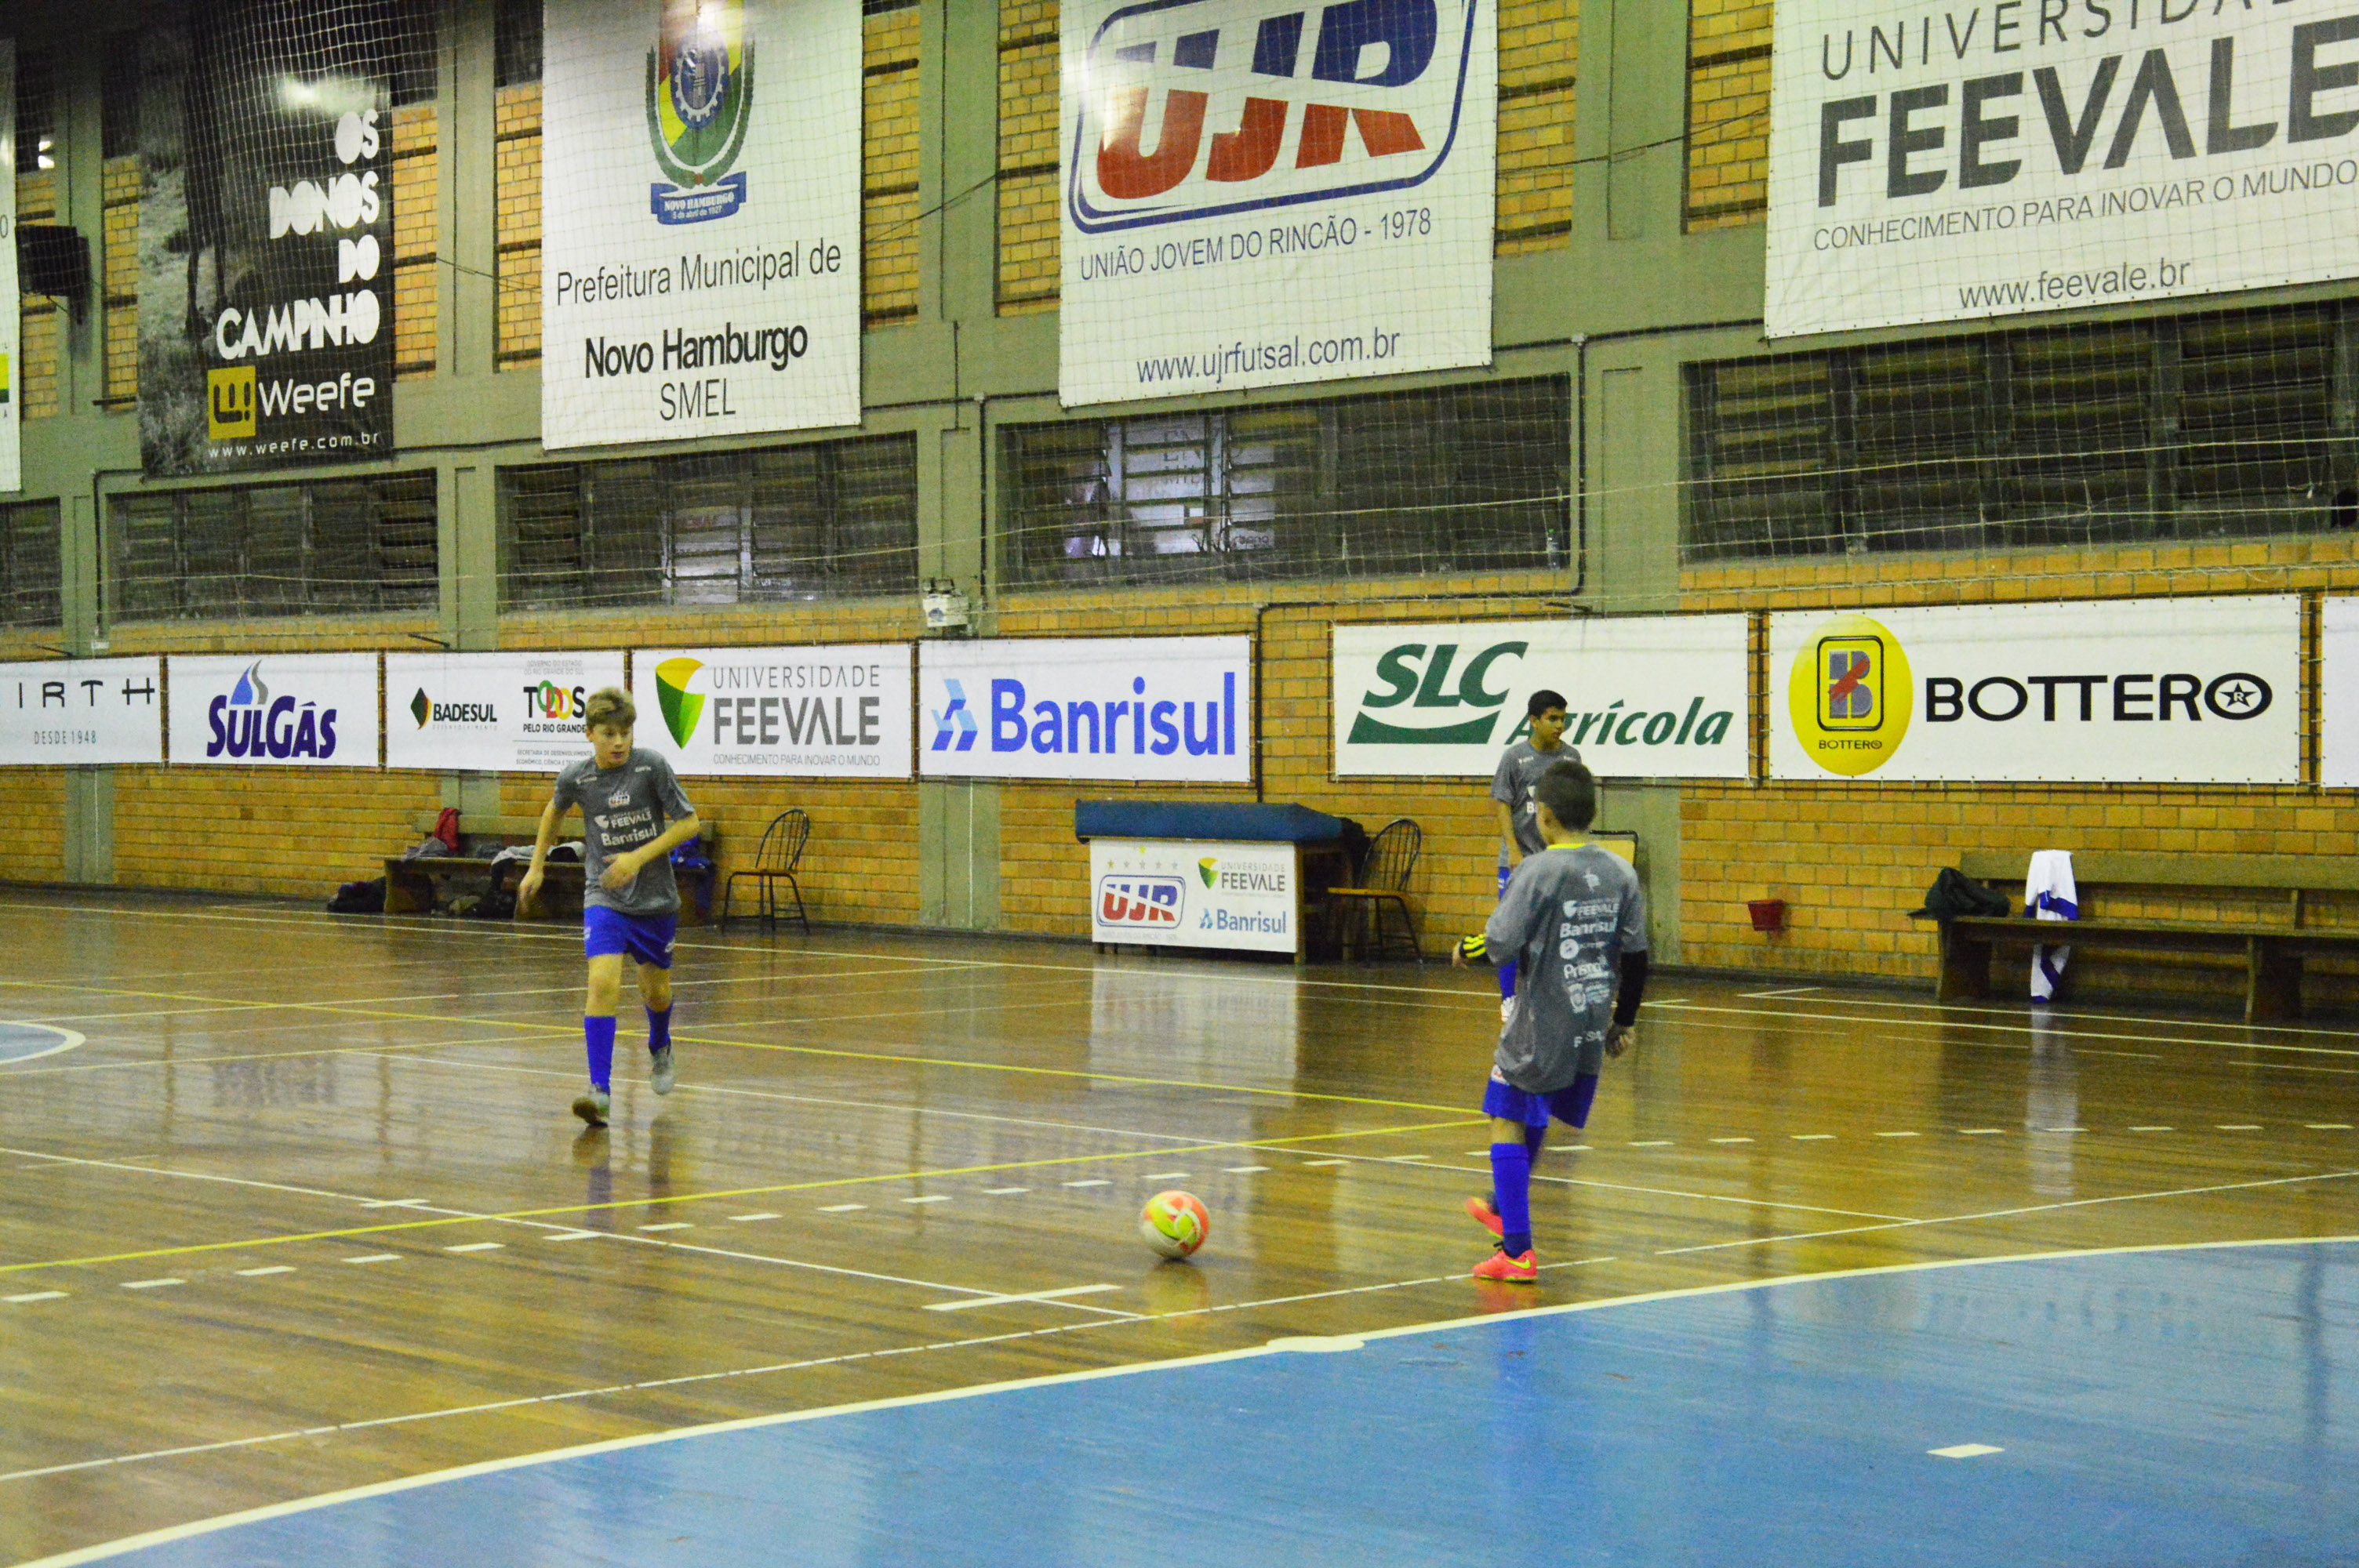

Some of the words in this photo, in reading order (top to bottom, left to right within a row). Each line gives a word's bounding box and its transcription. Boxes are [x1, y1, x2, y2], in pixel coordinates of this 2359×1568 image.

[1821, 0, 2294, 81] UNIVERSID
[1097, 0, 1438, 199] UJR
[1818, 14, 2359, 209] FEEVALE
[334, 108, 380, 164] OS
[269, 170, 380, 239] DONOS
[664, 200, 686, 211] NOVO
[687, 191, 735, 209] HAMBURGO
[1813, 205, 2016, 251] CONHECIMENTO
[2023, 195, 2094, 226] PARA
[2102, 180, 2205, 216] INOVAR
[2213, 176, 2234, 201] O
[2242, 159, 2358, 198] MUNDO
[338, 234, 380, 283] DO
[1080, 245, 1145, 281] UNIÃO
[1150, 236, 1223, 271] JOVEM
[1230, 230, 1263, 260] DO
[1270, 215, 1358, 255] RINCÃO
[1380, 207, 1432, 240] 1978
[558, 266, 671, 306] Prefeitura
[681, 240, 799, 291] Municipal
[809, 238, 841, 274] de
[1958, 257, 2191, 308] www.feevale.br
[216, 289, 380, 360] CAMPINHO
[586, 336, 654, 378] Novo
[663, 321, 809, 372] Hamburgo
[1136, 326, 1401, 383] www.ujrfutsal.com.br
[259, 372, 375, 417] Weefe
[660, 377, 736, 421] SMEL
[208, 431, 379, 458] www.weefe.com.br
[19, 677, 155, 708] IRTH
[713, 664, 881, 689] UNIVERSIDADE
[1361, 641, 1529, 708] SLC
[433, 703, 497, 722] BADESUL
[523, 680, 586, 720] TODOS
[991, 671, 1236, 757] Banrisul
[1925, 672, 2273, 722] BOTTERO
[34, 731, 67, 745] DESDE
[71, 730, 97, 745] 1948
[523, 724, 541, 733] PELO
[543, 724, 555, 733] RIO
[557, 724, 586, 733] GRANDE
[714, 696, 881, 746] FEEVALE
[713, 753, 779, 765] CONHECIMENTO
[780, 754, 803, 765] PARA
[805, 754, 835, 766] INOVAR
[838, 755, 845, 766] O
[847, 755, 881, 766] MUNDO
[1819, 739, 1882, 750] BOTTERO
[601, 823, 658, 847] Banrisul
[610, 811, 652, 829] FEEVALE
[1221, 862, 1285, 873] UNIVERSIDADE
[1221, 872, 1285, 892] FEEVALE
[1103, 884, 1178, 922] UJR
[1216, 909, 1287, 935] Banrisul
[1560, 917, 1618, 938] Banrsul
